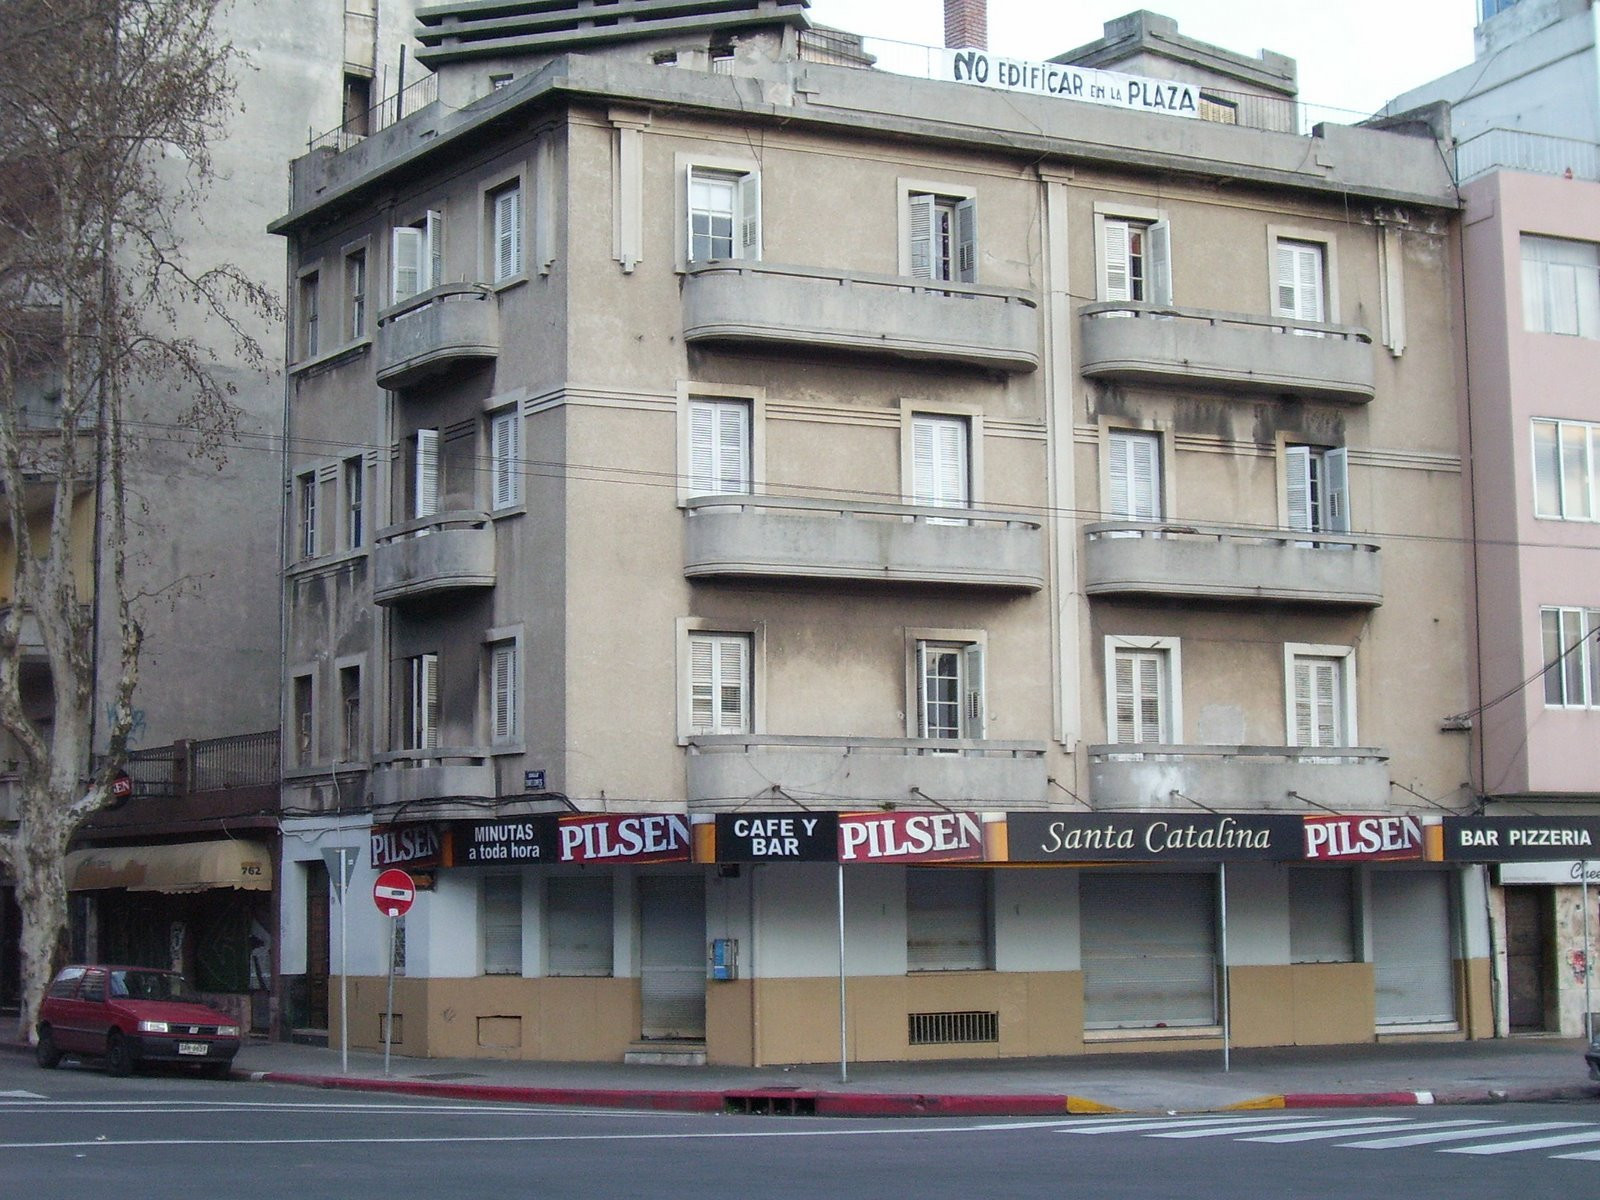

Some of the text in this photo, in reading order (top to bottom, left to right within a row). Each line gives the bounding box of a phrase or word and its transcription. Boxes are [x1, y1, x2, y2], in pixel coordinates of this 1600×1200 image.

[954, 51, 1196, 112] NO EDIFICAR EN LA PLAZA
[474, 823, 534, 843] MINUTAS
[559, 815, 690, 861] PILSEN
[734, 819, 818, 837] CAFE Y
[840, 813, 982, 859] PILSEN
[1041, 817, 1271, 853] Santa Catalina
[1304, 816, 1423, 858] PILSEN
[1460, 830, 1592, 846] BAR PIZZERIA
[371, 829, 439, 866] PILSEN
[469, 842, 540, 860] a toda hora
[752, 838, 799, 856] BAR
[241, 866, 262, 875] 762
